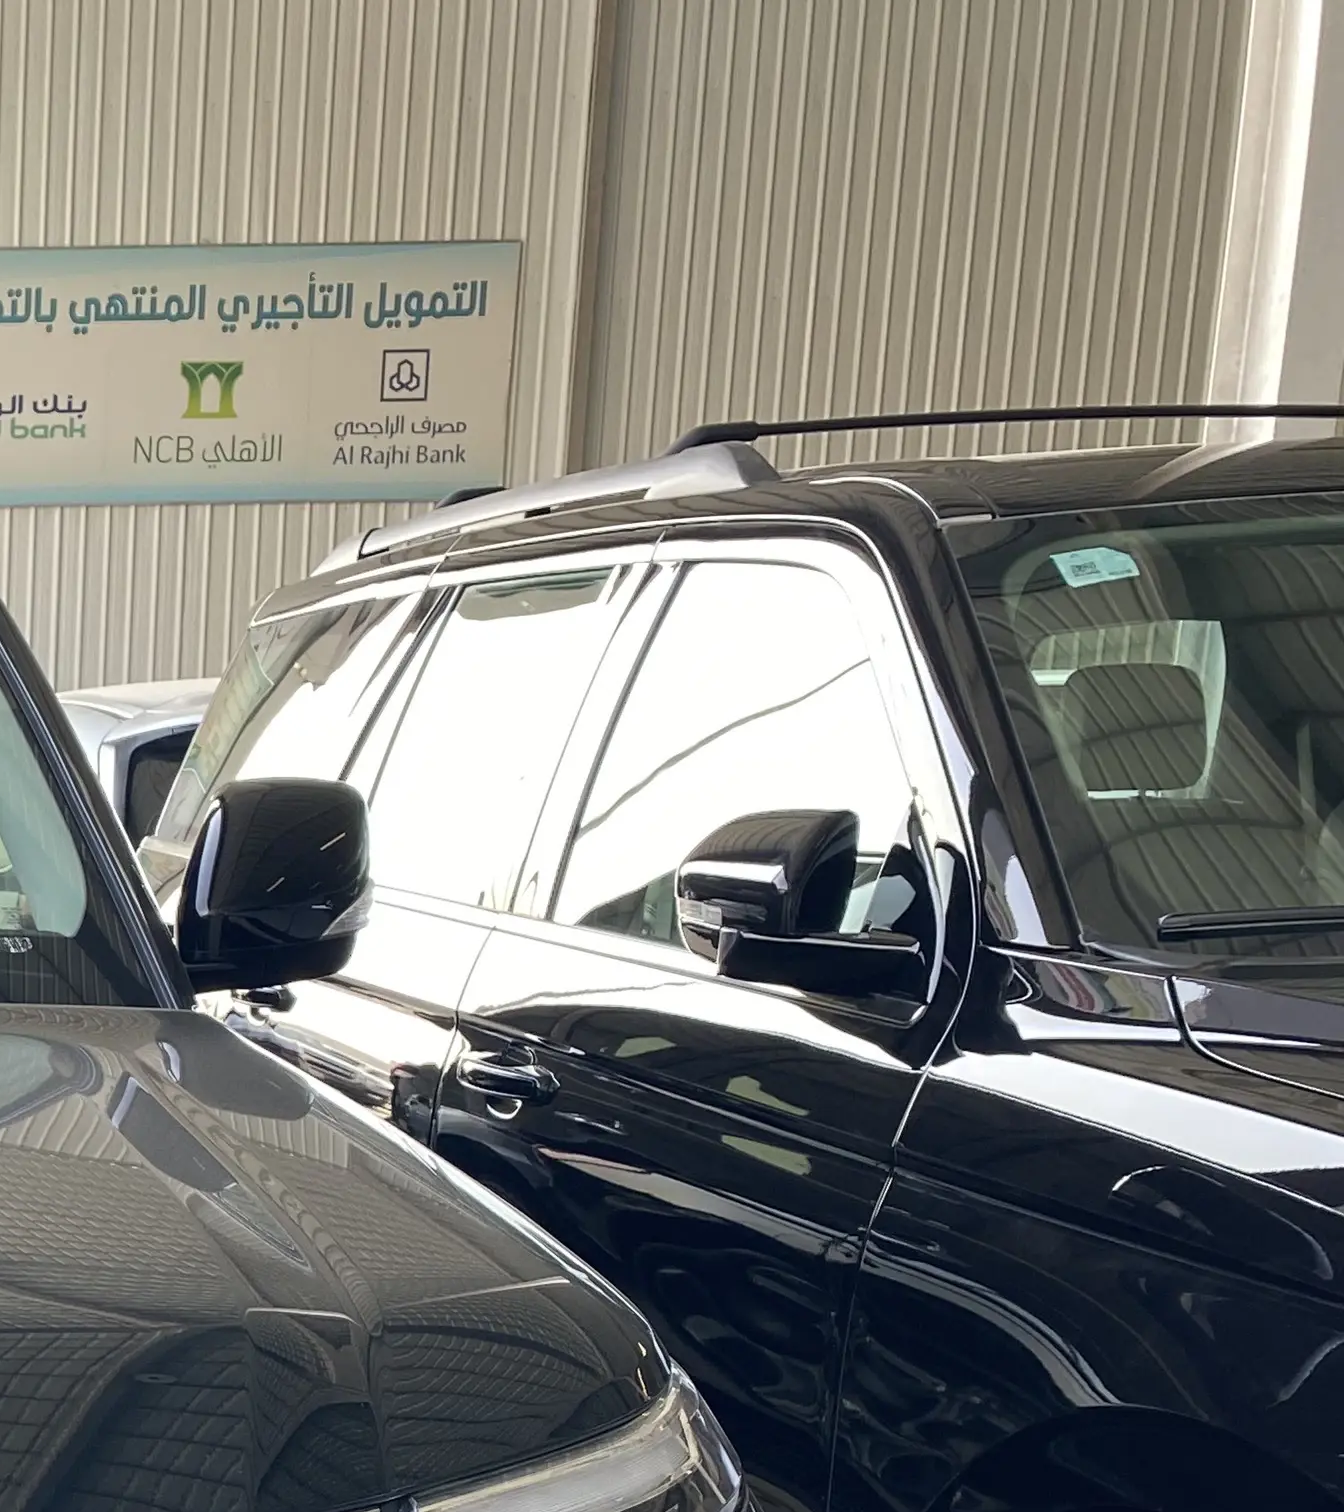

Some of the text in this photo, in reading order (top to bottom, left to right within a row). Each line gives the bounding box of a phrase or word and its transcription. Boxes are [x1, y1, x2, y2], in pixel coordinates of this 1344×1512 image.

[69, 284, 206, 335] المنتهي
[217, 271, 354, 333] التأجيري
[364, 280, 488, 328] التمويل
[29, 394, 87, 419] بنك
[10, 417, 86, 439] bank
[334, 415, 467, 441] مصرف الراجحي
[133, 435, 194, 463] NCB
[202, 433, 282, 469] الأهلي
[333, 444, 465, 469] Al Rajhi Bank
